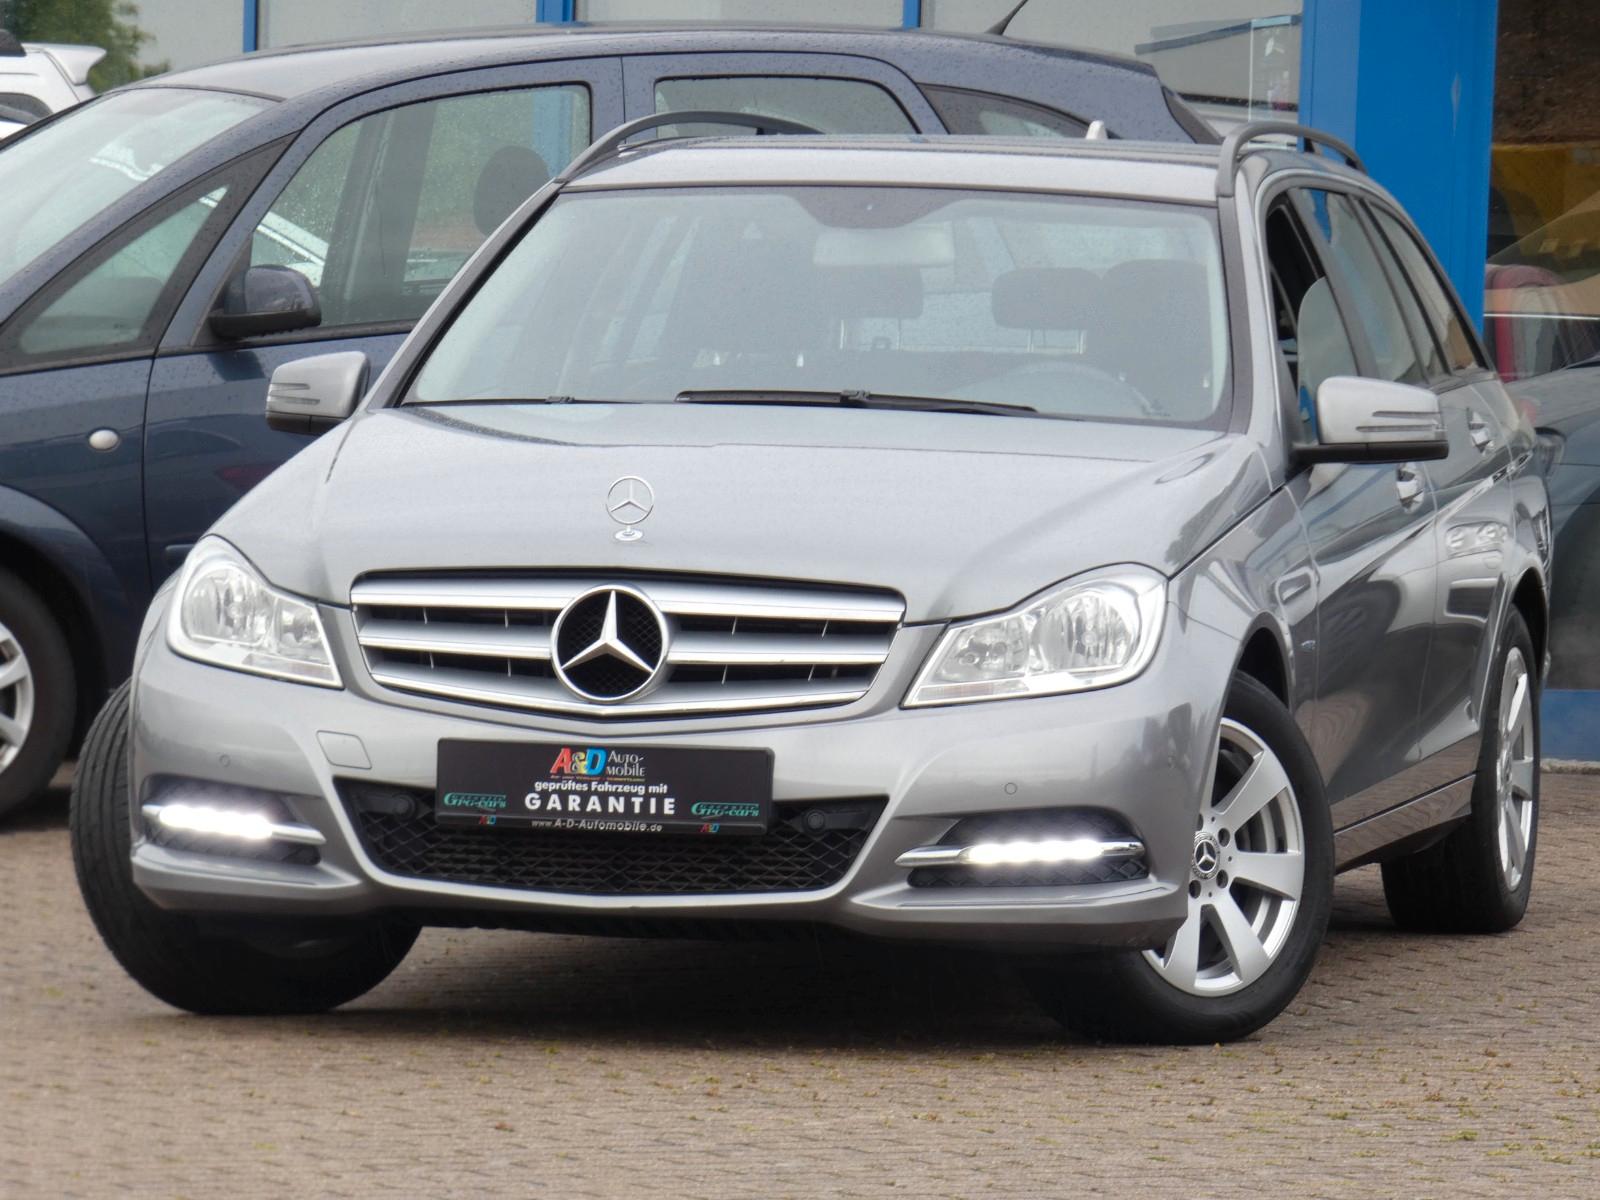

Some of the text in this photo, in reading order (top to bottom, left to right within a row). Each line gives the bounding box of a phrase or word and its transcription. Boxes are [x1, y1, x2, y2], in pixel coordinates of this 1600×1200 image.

[549, 747, 607, 776] A&D
[534, 779, 668, 795] geprüftes Fahrzeug mit
[524, 793, 676, 815] GARANTIE
